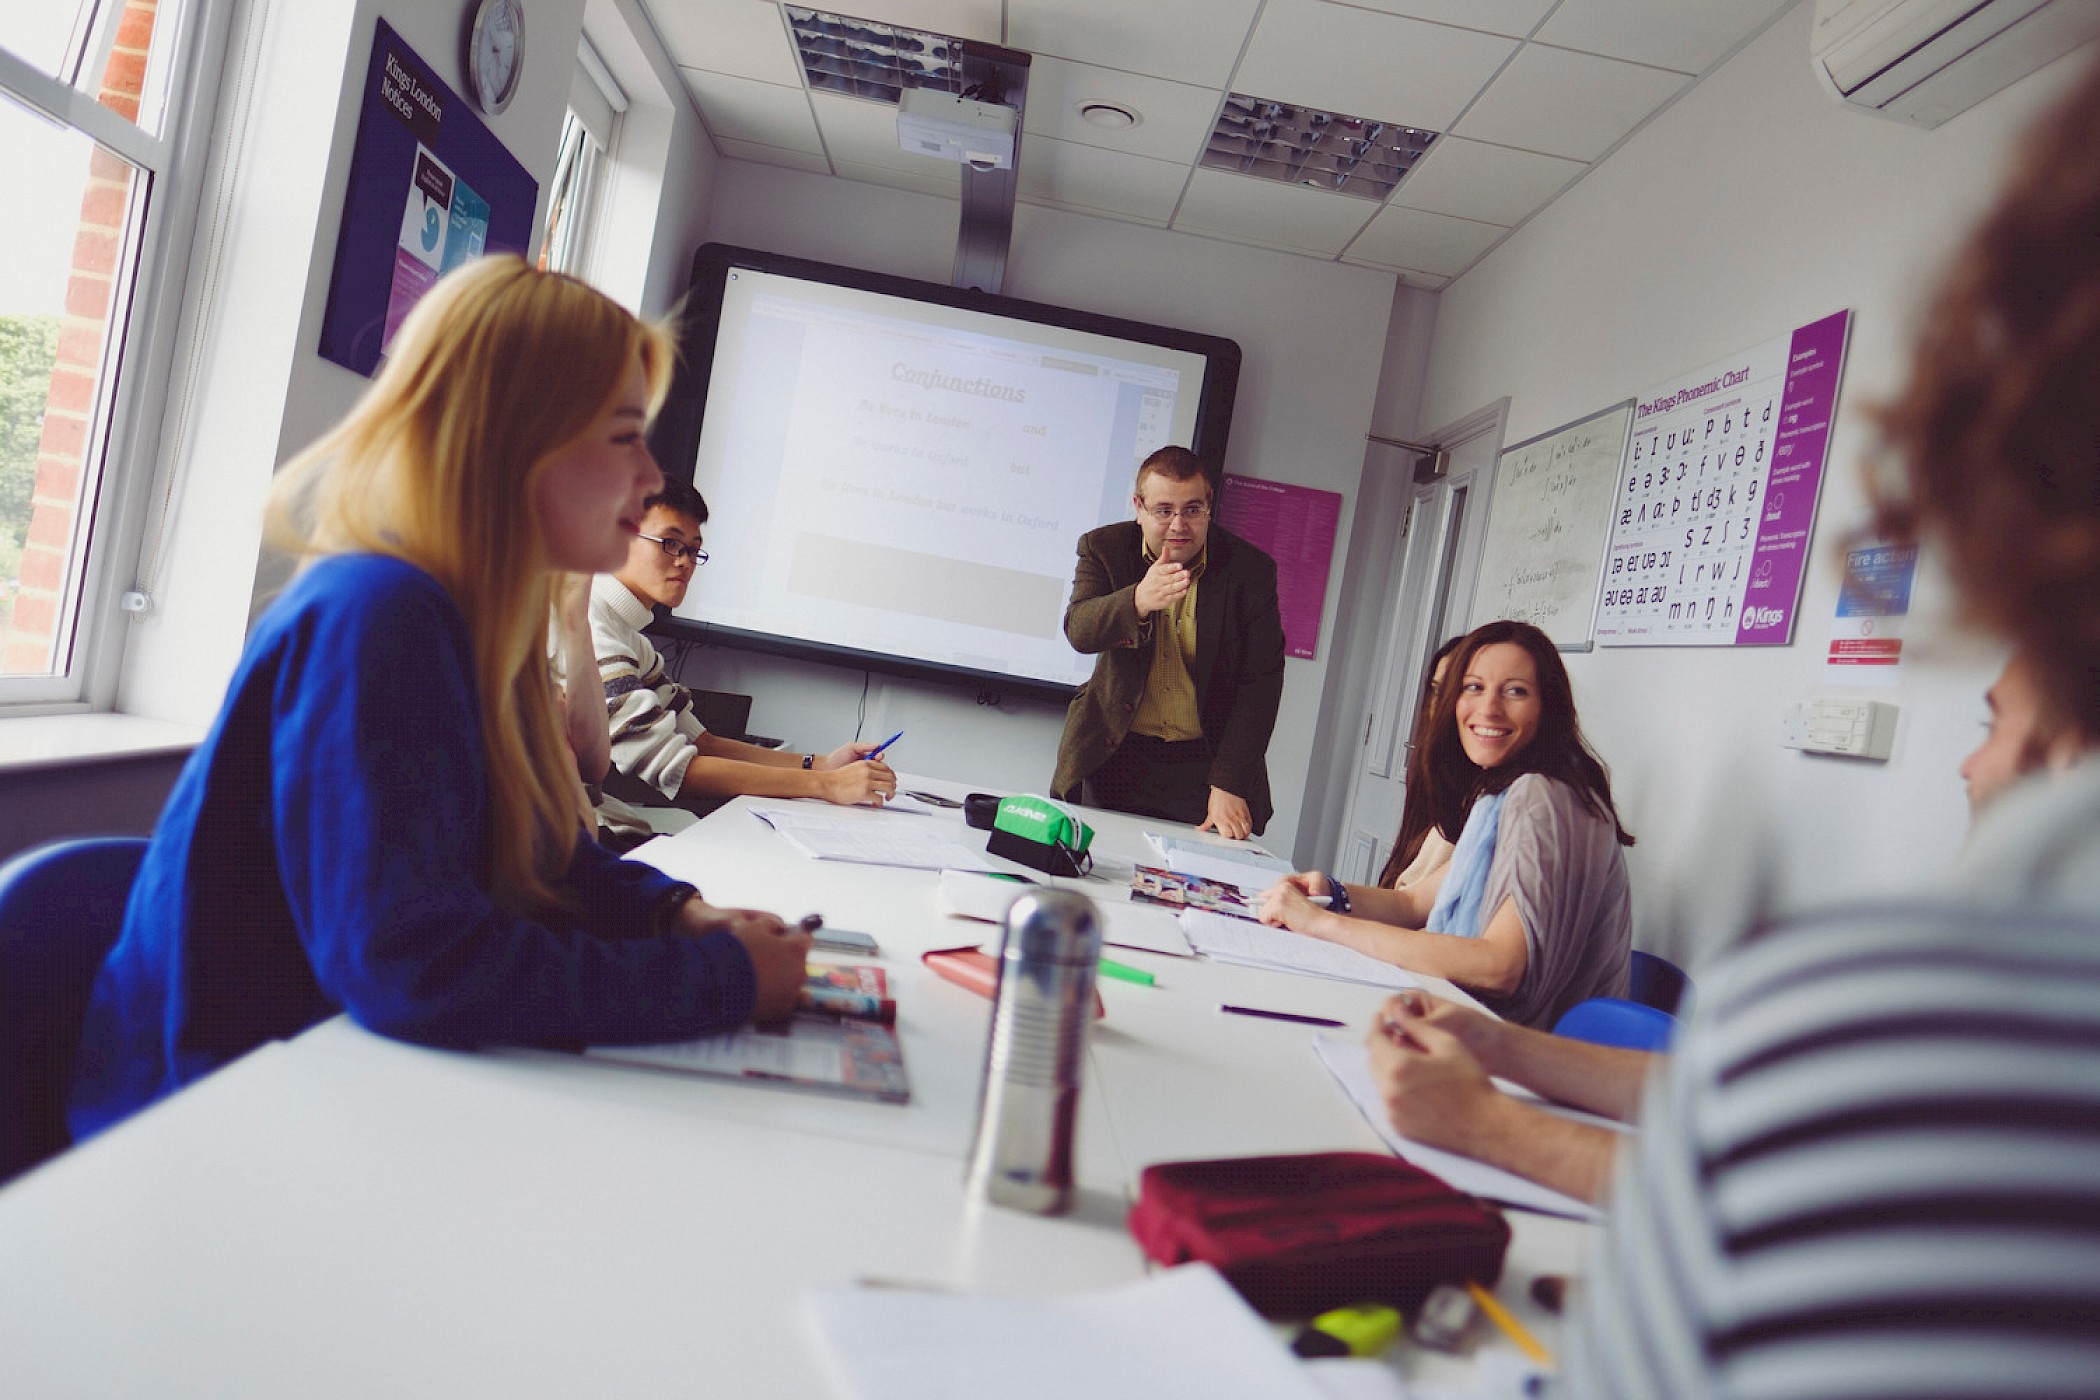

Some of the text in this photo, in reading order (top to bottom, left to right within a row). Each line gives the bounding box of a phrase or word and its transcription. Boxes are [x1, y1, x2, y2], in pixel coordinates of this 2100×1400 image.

[382, 77, 413, 119] Notices
[386, 53, 442, 122] Kings London
[892, 362, 1026, 402] Conjunctions
[1638, 366, 1749, 419] The Kings Phonemic Chart
[926, 412, 970, 429] London
[1022, 424, 1047, 437] and
[1705, 419, 1714, 440] p
[1723, 414, 1731, 434] b
[1744, 408, 1750, 428] t
[1762, 400, 1771, 421] d
[928, 449, 969, 467] Oxford
[1010, 460, 1030, 475] but
[1700, 454, 1708, 476] f
[1718, 452, 1727, 470] v
[1729, 484, 1737, 505] k
[890, 489, 932, 507] London
[937, 499, 956, 512] but
[961, 505, 997, 520] works
[1001, 510, 1013, 523] in
[1017, 514, 1060, 531] Oxford
[1695, 564, 1705, 582] r
[1712, 561, 1726, 580] w
[1732, 555, 1742, 580] j
[1848, 551, 1871, 567] Fire
[1669, 601, 1681, 620] m
[1687, 601, 1696, 619] n
[1724, 595, 1733, 618] h
[1756, 606, 1784, 627] Kings
